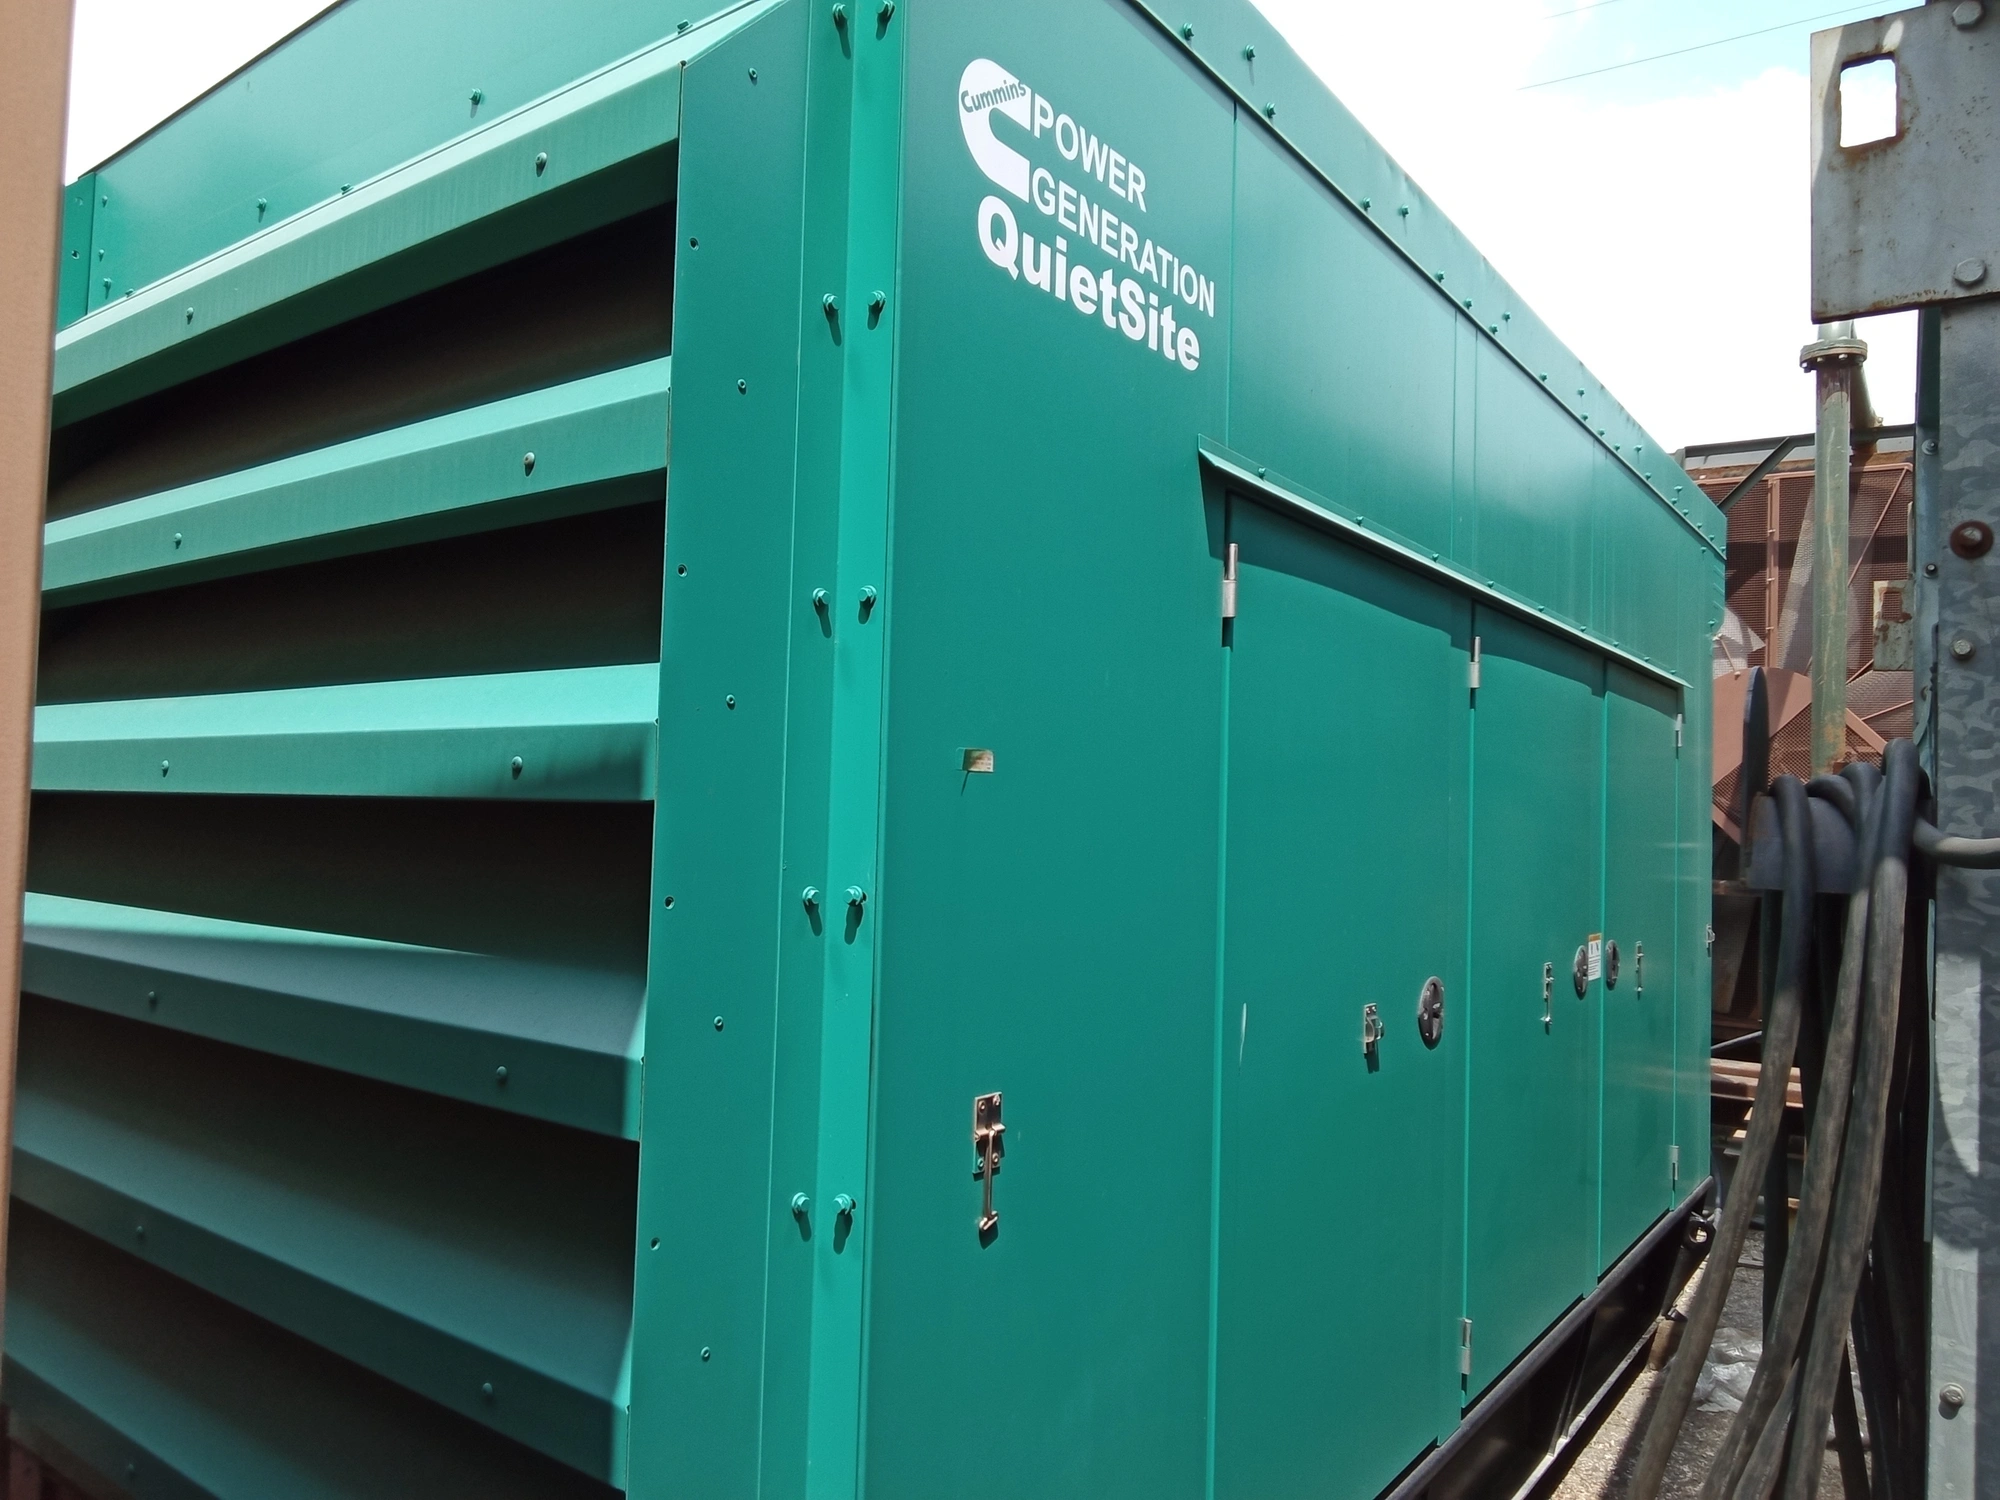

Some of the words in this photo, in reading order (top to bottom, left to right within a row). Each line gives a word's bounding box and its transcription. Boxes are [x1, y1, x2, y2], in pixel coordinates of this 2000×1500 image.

[961, 80, 1027, 113] Cummins
[1034, 93, 1147, 213] POWER
[977, 195, 1200, 371] QuietSite
[1032, 167, 1215, 318] GENERATION
